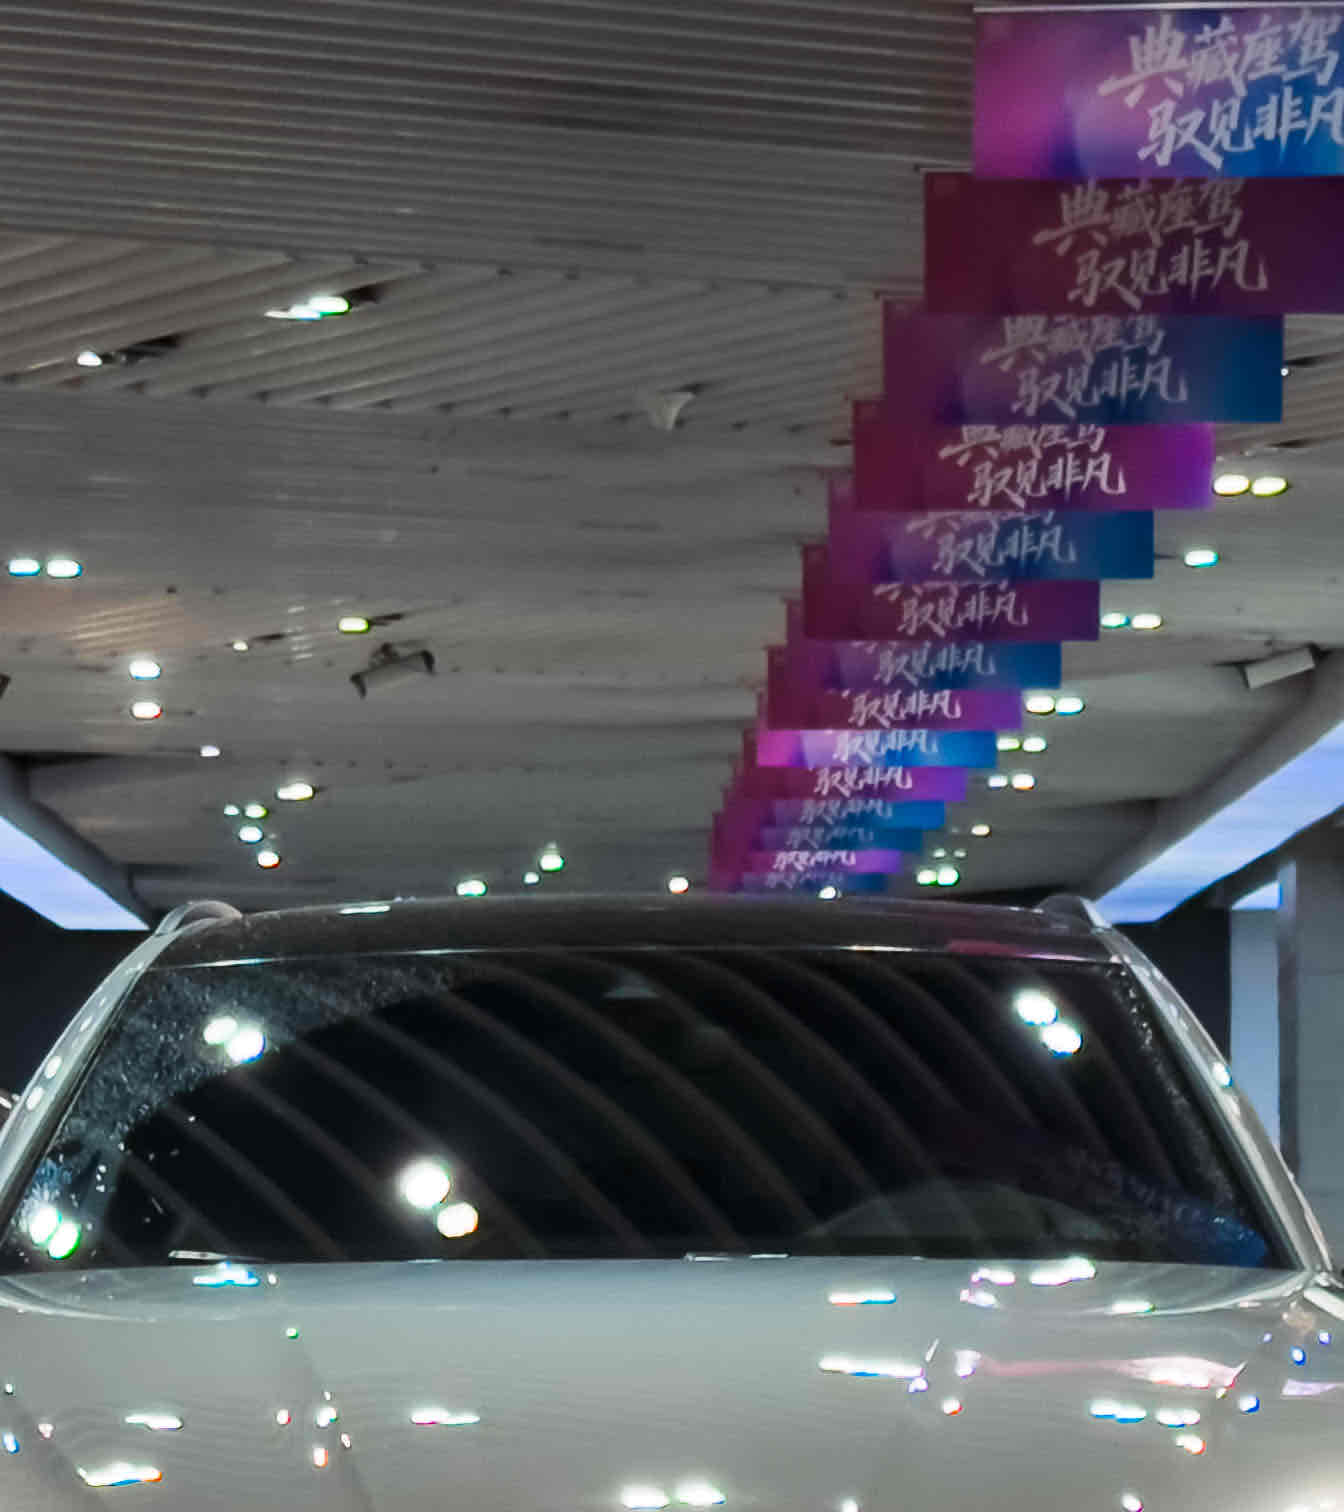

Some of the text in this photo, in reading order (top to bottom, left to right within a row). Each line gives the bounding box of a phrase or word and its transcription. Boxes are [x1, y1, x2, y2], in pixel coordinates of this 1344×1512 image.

[1097, 10, 1342, 108] 典藏座驾
[1067, 238, 1269, 310] 驭见非凡
[1011, 355, 1188, 418] 驭见非凡
[967, 452, 1126, 509] 驭见非凡
